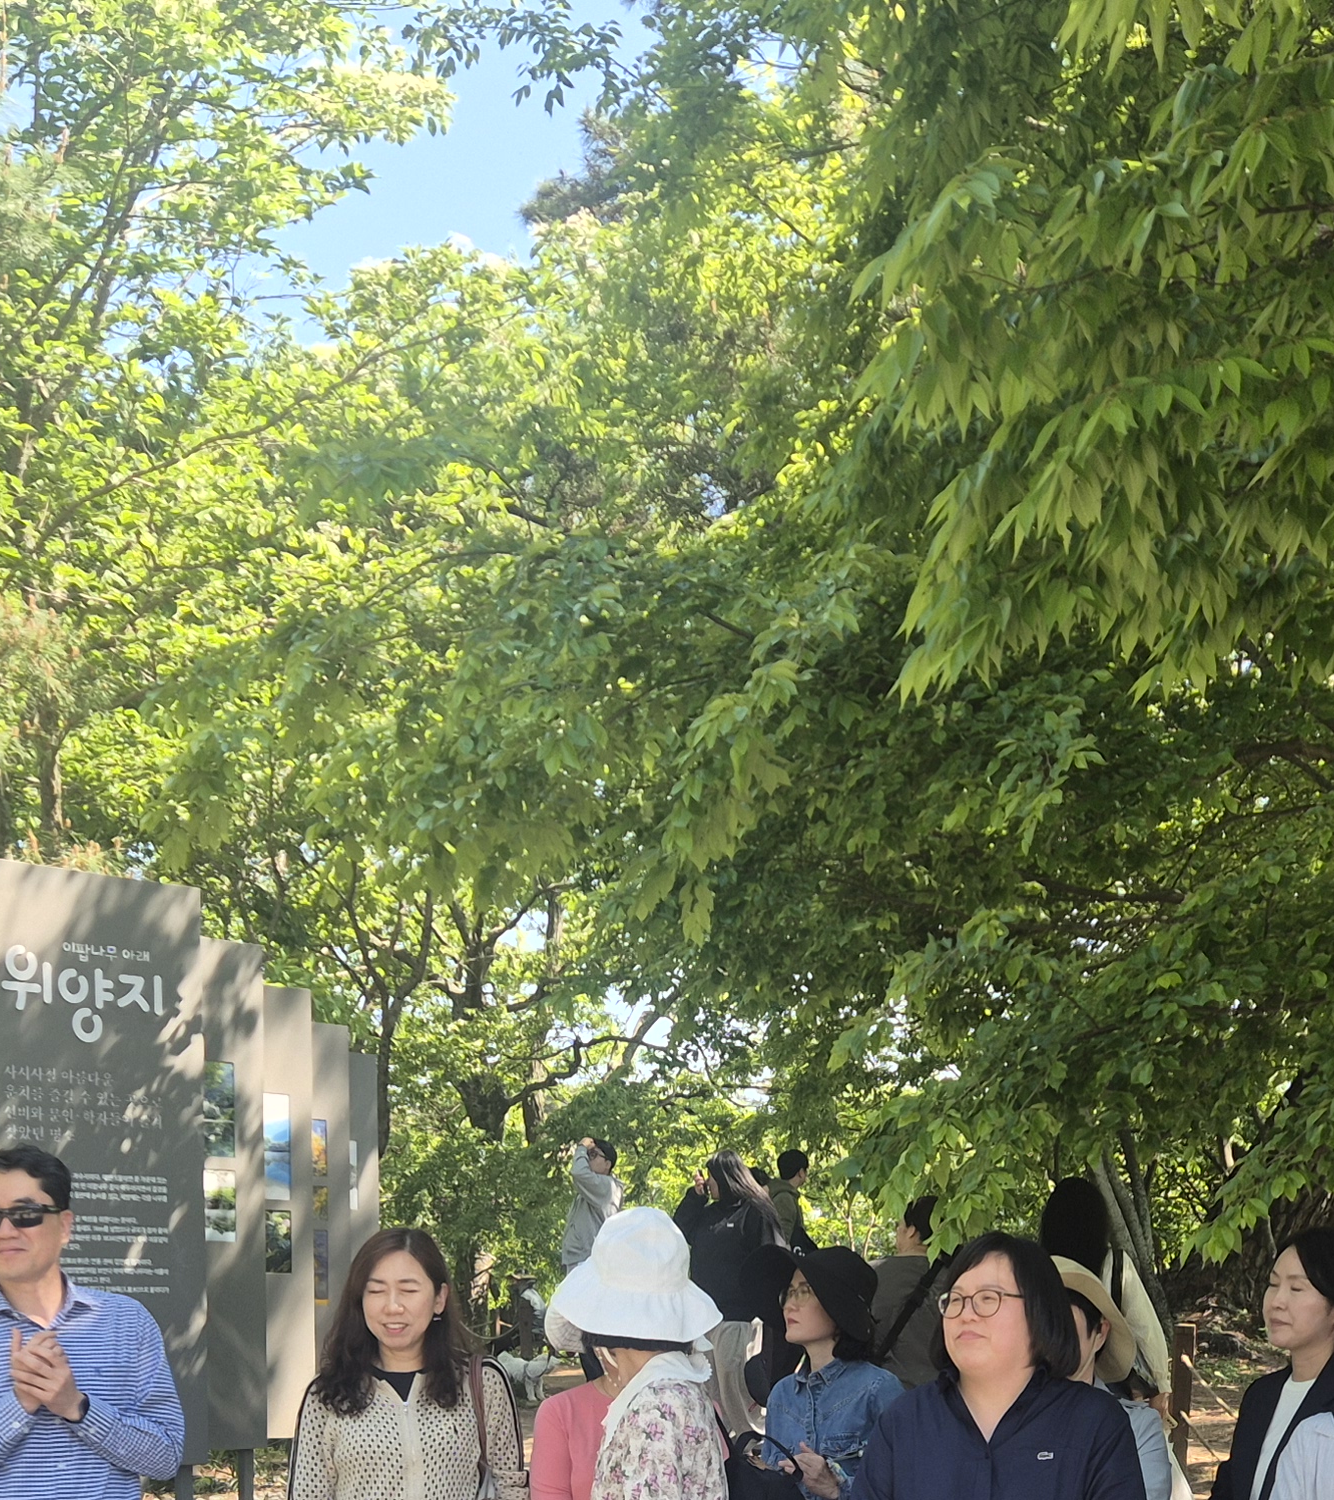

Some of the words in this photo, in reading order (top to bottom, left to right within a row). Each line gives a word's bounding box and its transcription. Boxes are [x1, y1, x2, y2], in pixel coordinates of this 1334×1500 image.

[62, 942, 117, 962] 이팝나무
[122, 949, 150, 962] 아래
[1, 944, 163, 1043] 위양지
[4, 1064, 56, 1083] 사시사철
[61, 1069, 114, 1087] 아름다운
[4, 1083, 44, 1100] 운치를
[81, 1089, 91, 1105] 수
[97, 1091, 121, 1107] 있는
[4, 1104, 44, 1122] 선비와
[5, 1124, 44, 1141] 찾았던
